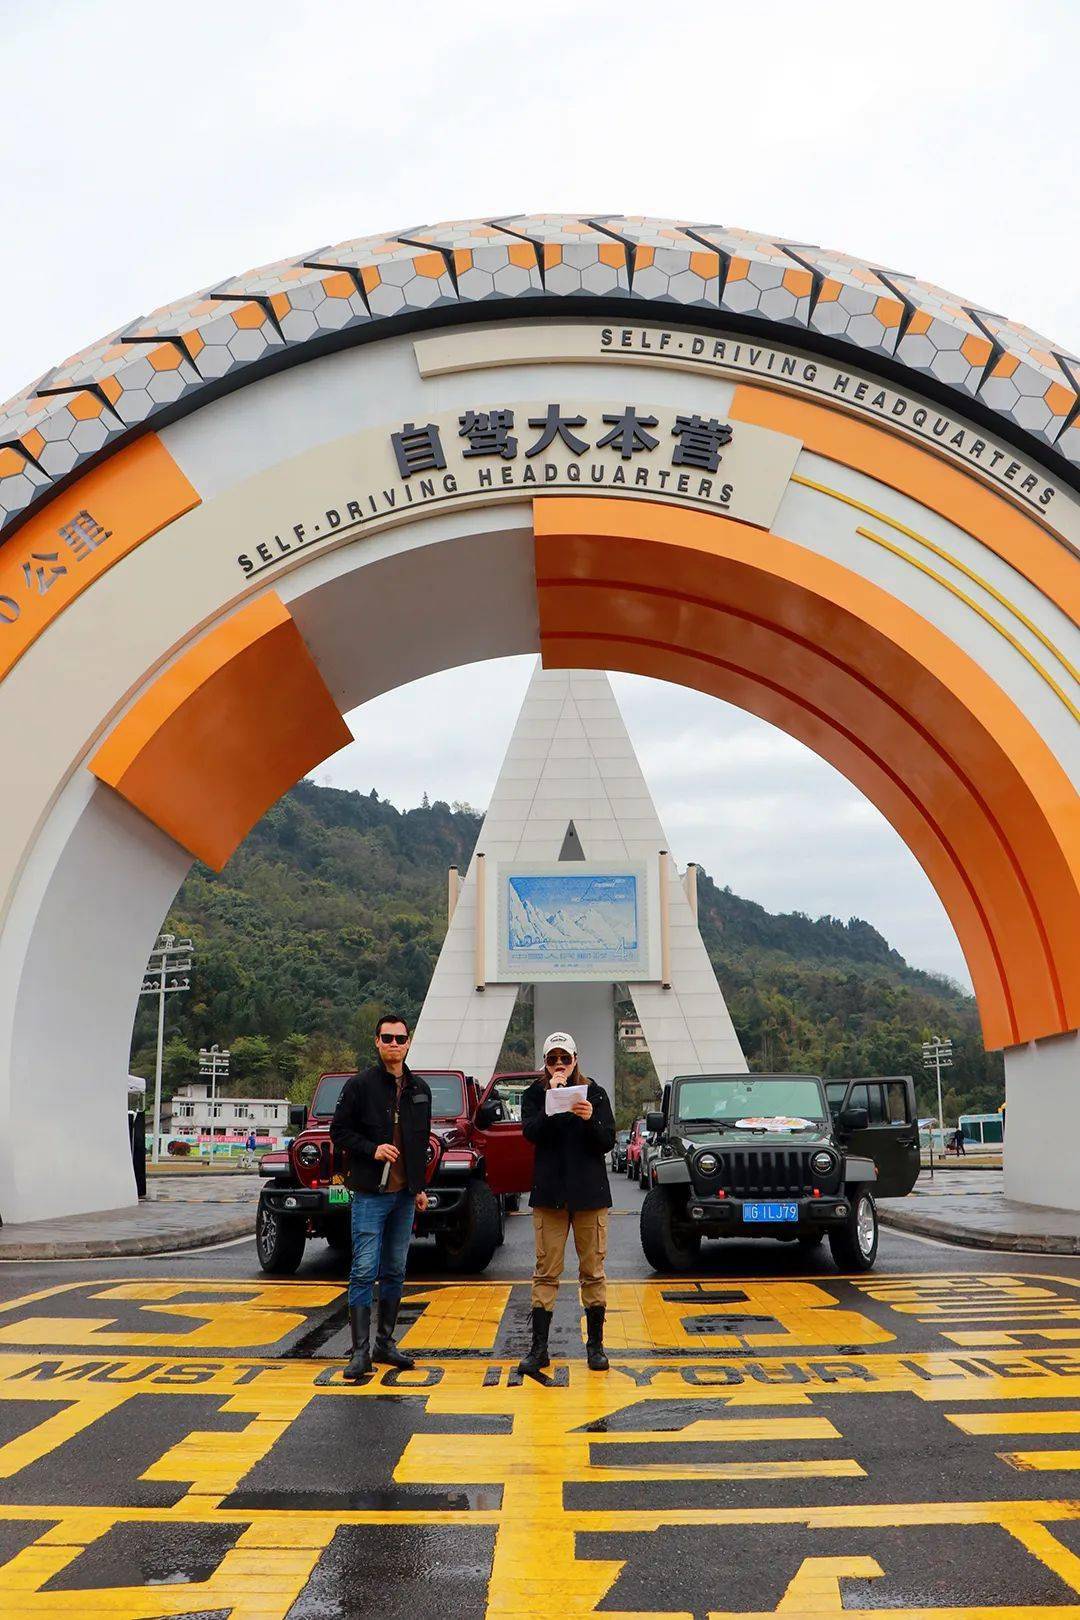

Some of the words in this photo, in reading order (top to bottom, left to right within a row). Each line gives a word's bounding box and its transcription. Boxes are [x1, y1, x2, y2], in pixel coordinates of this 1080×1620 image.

[390, 403, 734, 480] 自驾大本营
[833, 374, 1055, 505] HEADQUARTERS
[478, 462, 734, 502] HEADQUARTERS
[0, 1281, 898, 1349] 318
[3, 1360, 288, 1386] MUST
[481, 1365, 570, 1388] IN
[608, 1361, 879, 1388] YOUR
